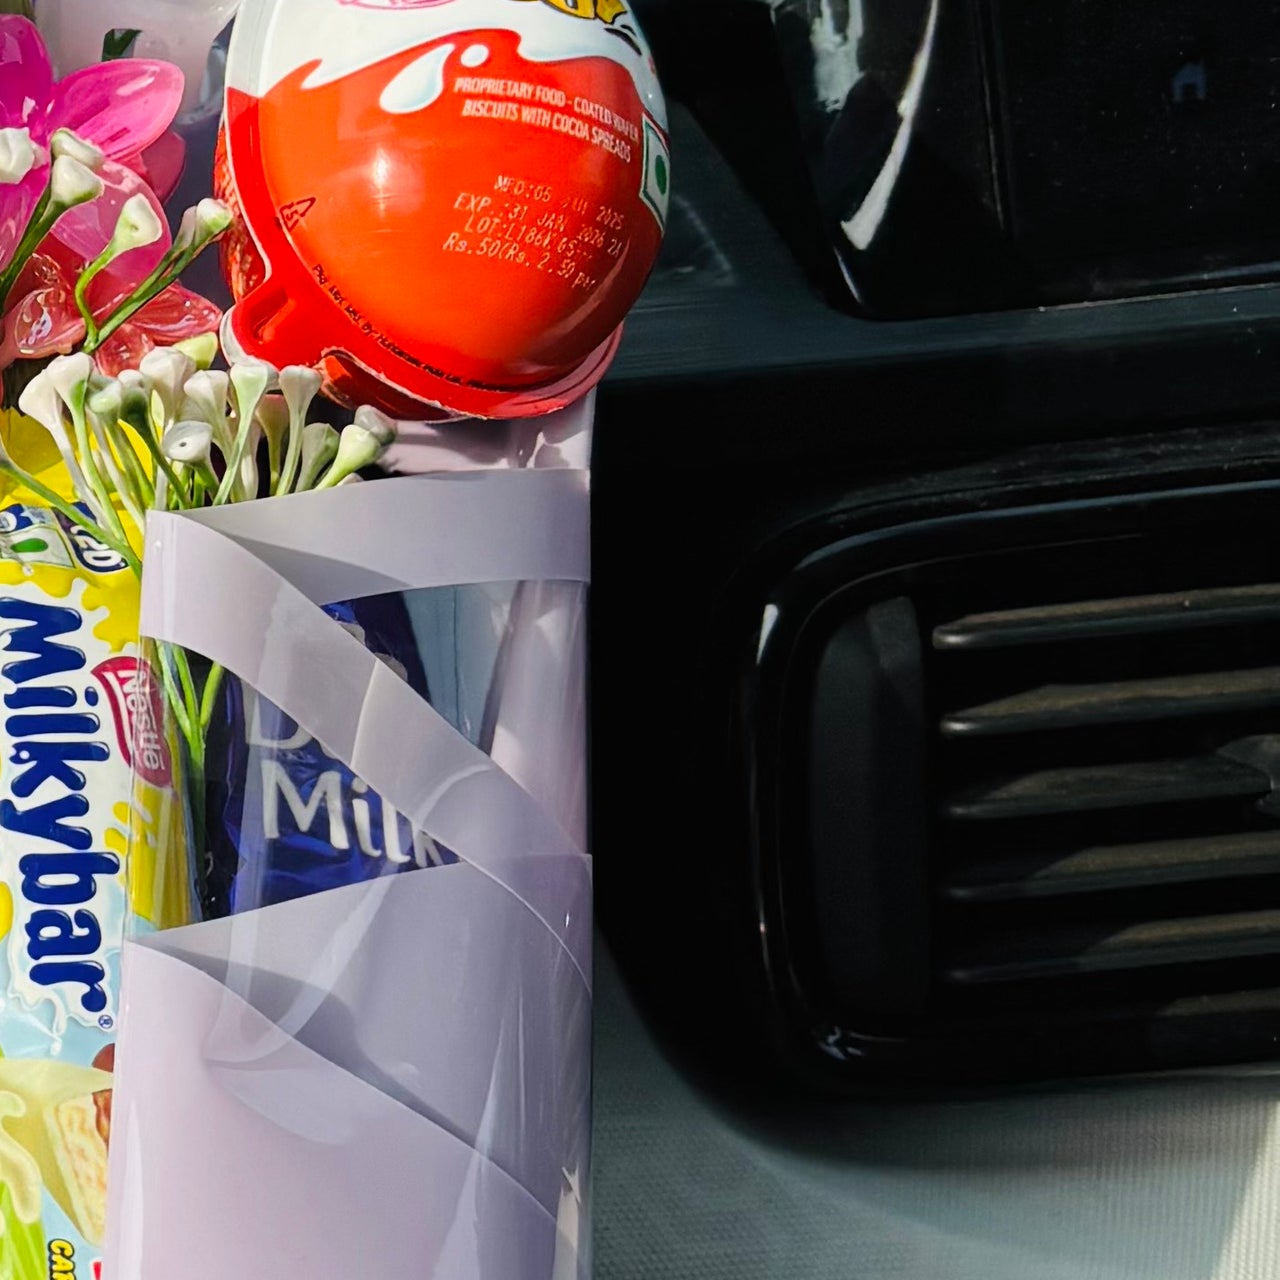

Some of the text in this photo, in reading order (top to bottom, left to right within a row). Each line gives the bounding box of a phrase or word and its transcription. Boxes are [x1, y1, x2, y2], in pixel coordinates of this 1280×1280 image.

[453, 76, 535, 99] PROPRIETARY
[535, 86, 567, 108] FOOD
[573, 96, 613, 125] COATED
[461, 99, 632, 164] BISCUITS WITH COCOA SPREADS
